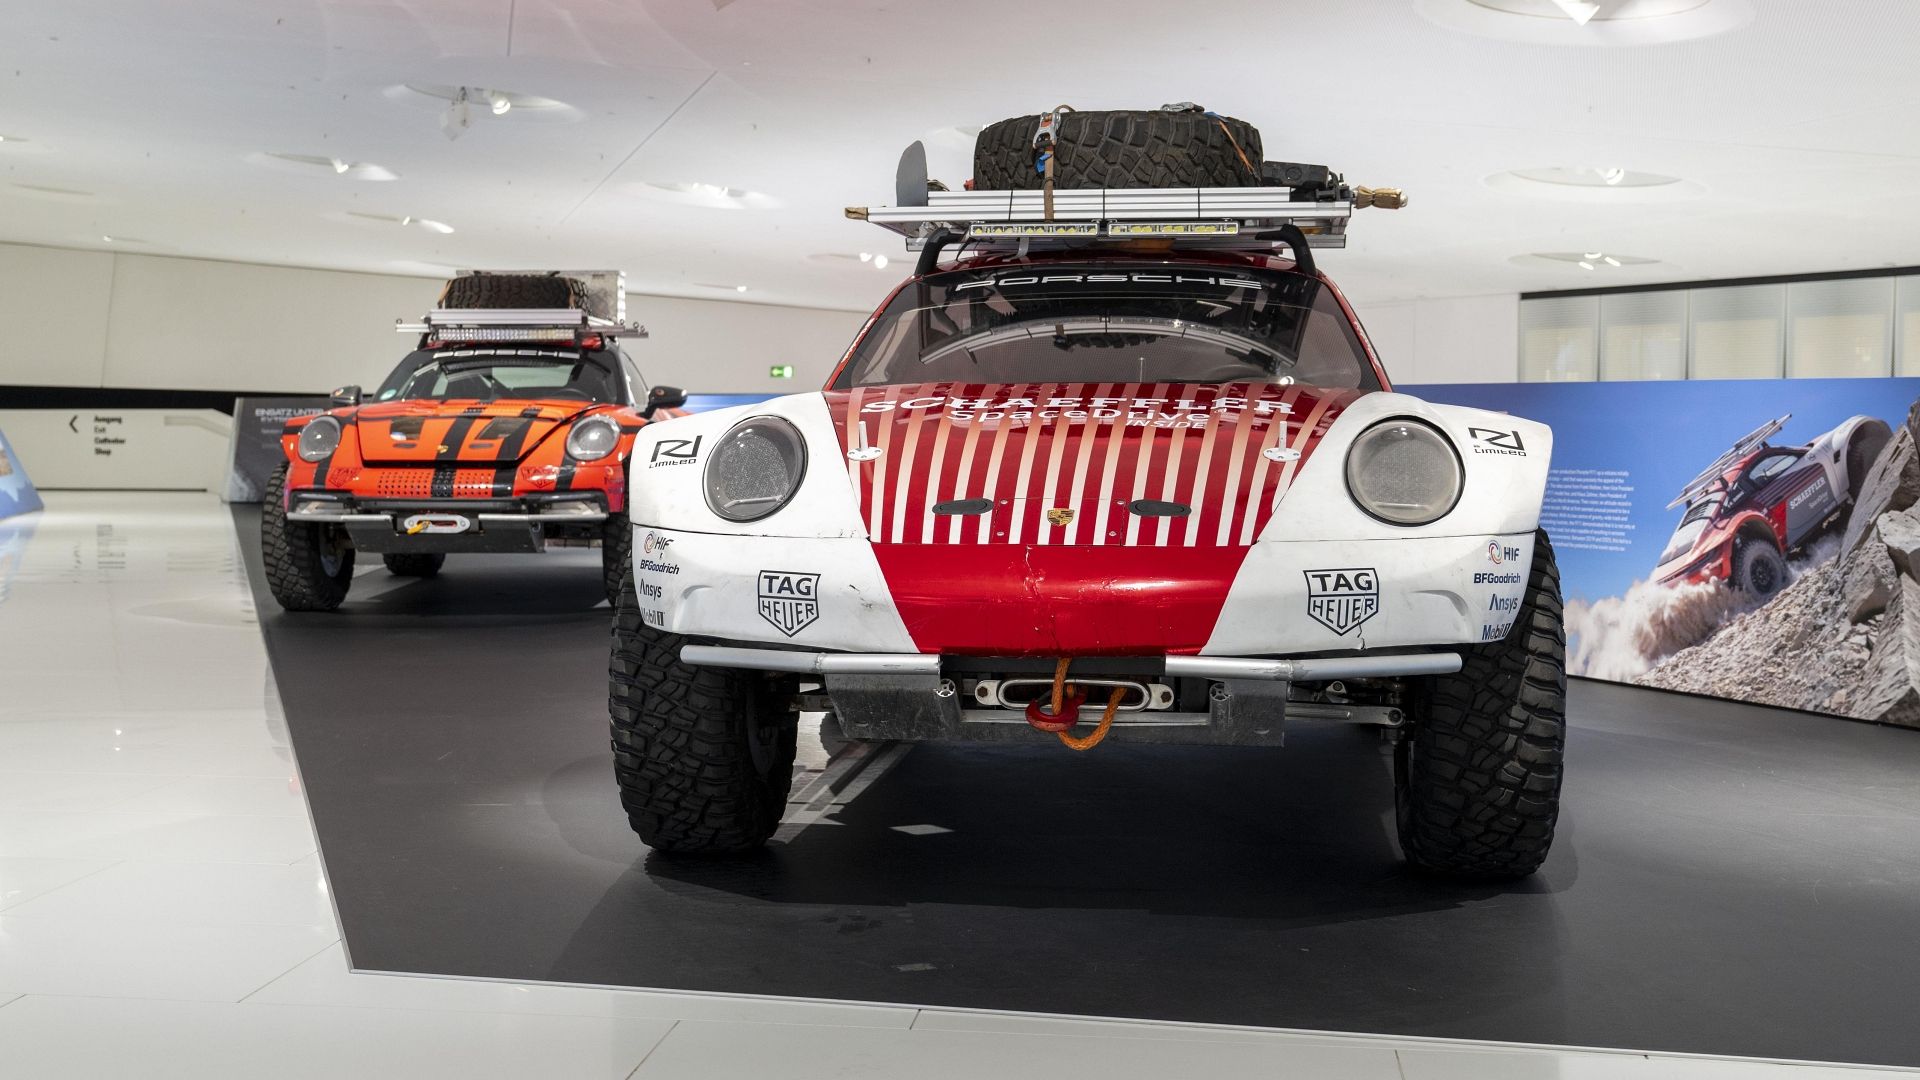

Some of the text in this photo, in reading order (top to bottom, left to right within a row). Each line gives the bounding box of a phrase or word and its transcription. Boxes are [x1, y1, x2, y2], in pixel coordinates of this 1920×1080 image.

[954, 275, 1262, 291] PORSCHE
[860, 396, 1297, 415] SCHAEFFLER
[1125, 420, 1206, 429] INSIDE
[654, 536, 674, 551] HIF
[1503, 546, 1520, 562] HIF
[640, 559, 680, 575] BFGoodrich
[763, 574, 813, 596] TAG
[1311, 572, 1373, 592] TAG
[1473, 572, 1521, 584] BFGoodrich
[639, 578, 662, 601] Ansys
[1488, 593, 1518, 614] Ansys
[761, 600, 815, 632] HEUER
[1312, 598, 1375, 630] HEUER
